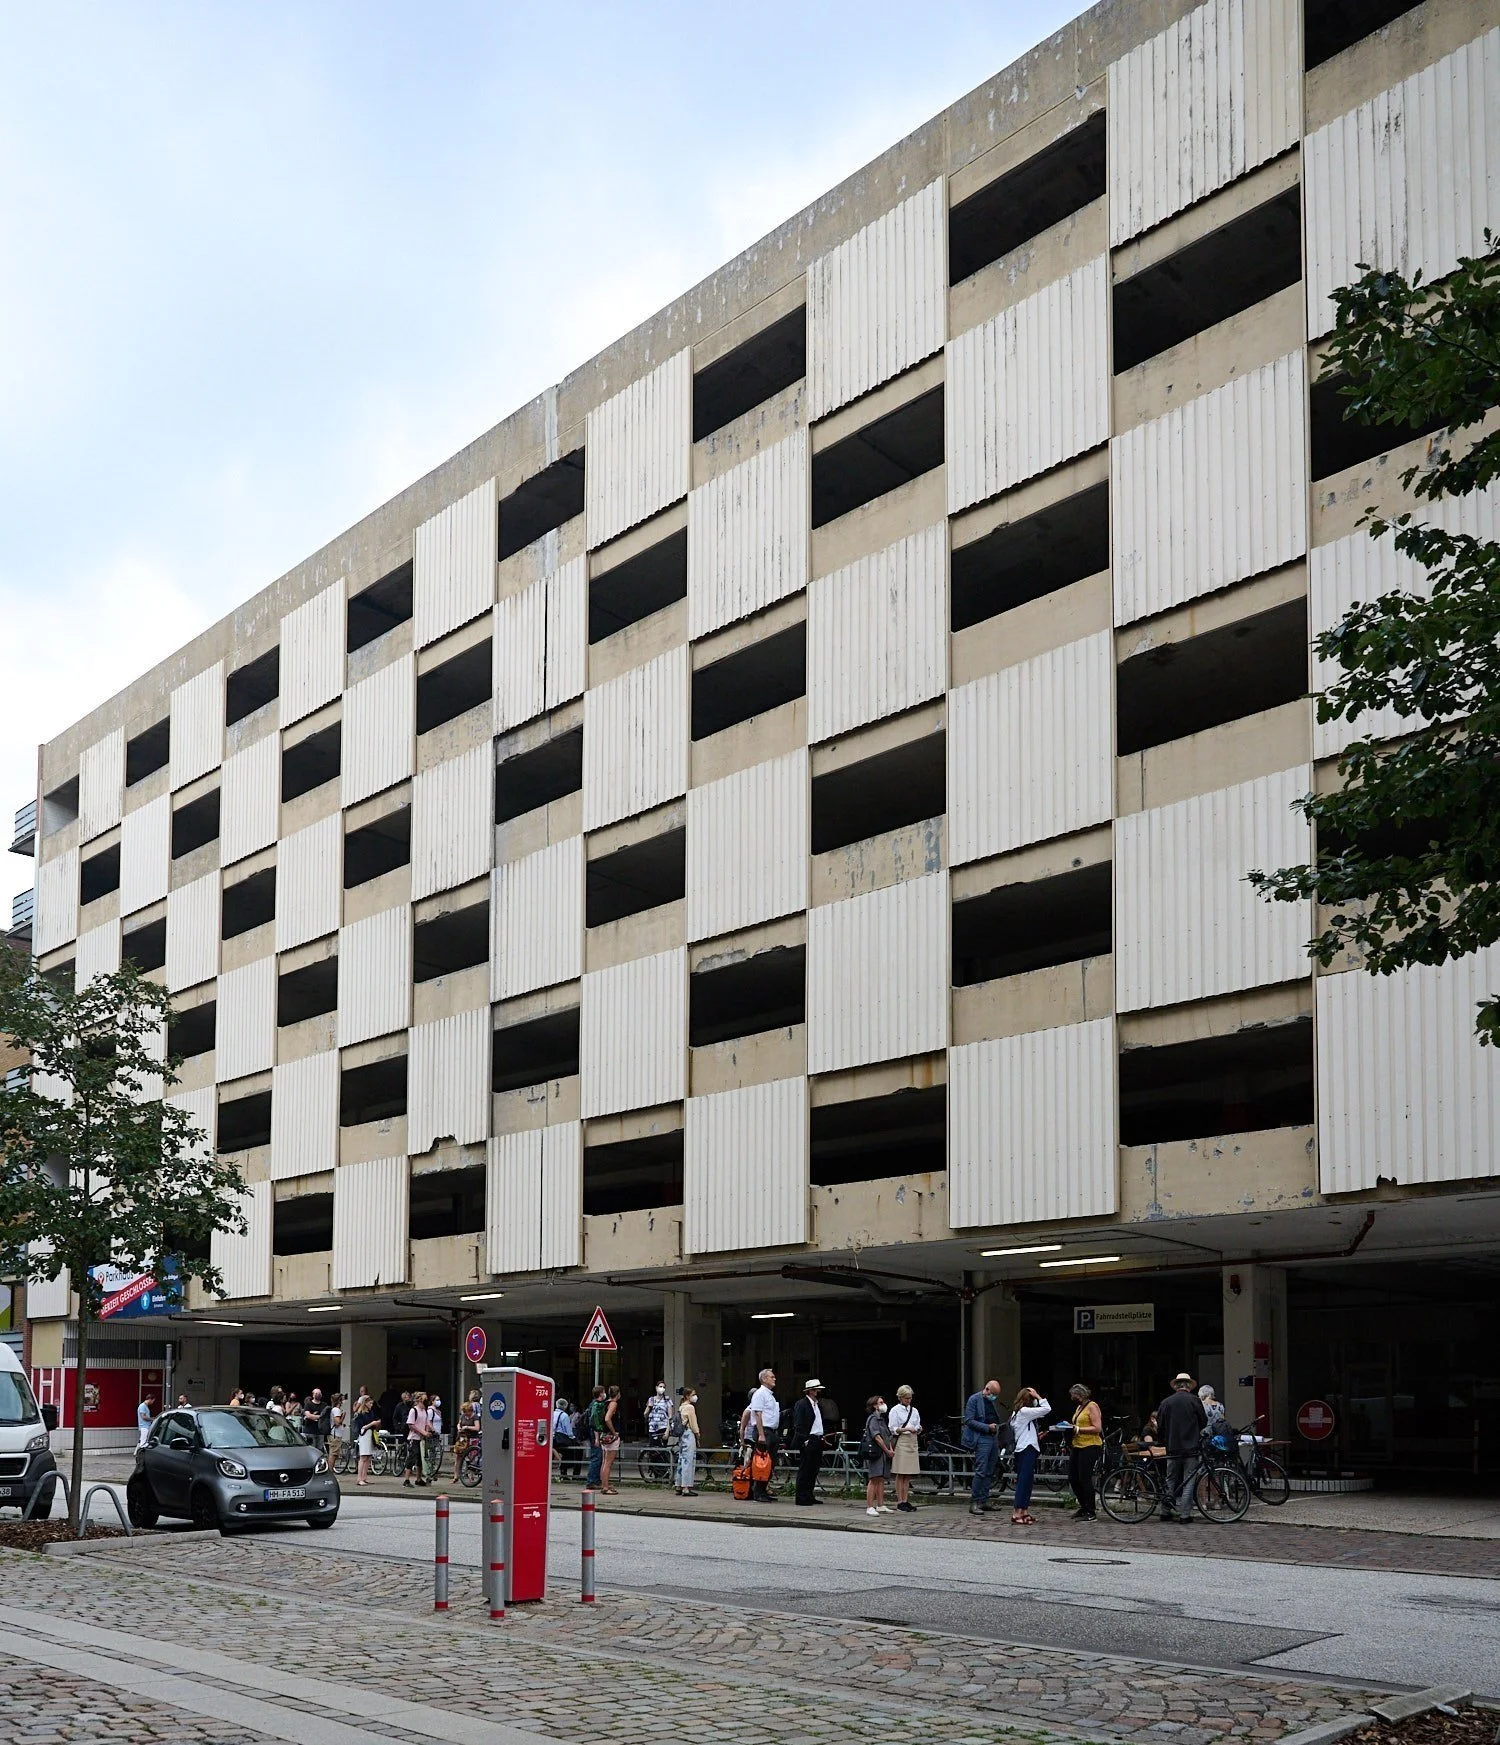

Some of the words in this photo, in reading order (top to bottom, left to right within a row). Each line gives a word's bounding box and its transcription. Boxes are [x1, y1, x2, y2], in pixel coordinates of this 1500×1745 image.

[105, 1270, 133, 1282] Parkhaus
[120, 1276, 154, 1303] GESCHLOSSE
[1081, 1312, 1091, 1327] P
[1096, 1311, 1152, 1321] Fahrradstellplätze
[535, 1388, 548, 1397] 7374
[270, 1490, 278, 1498] HH
